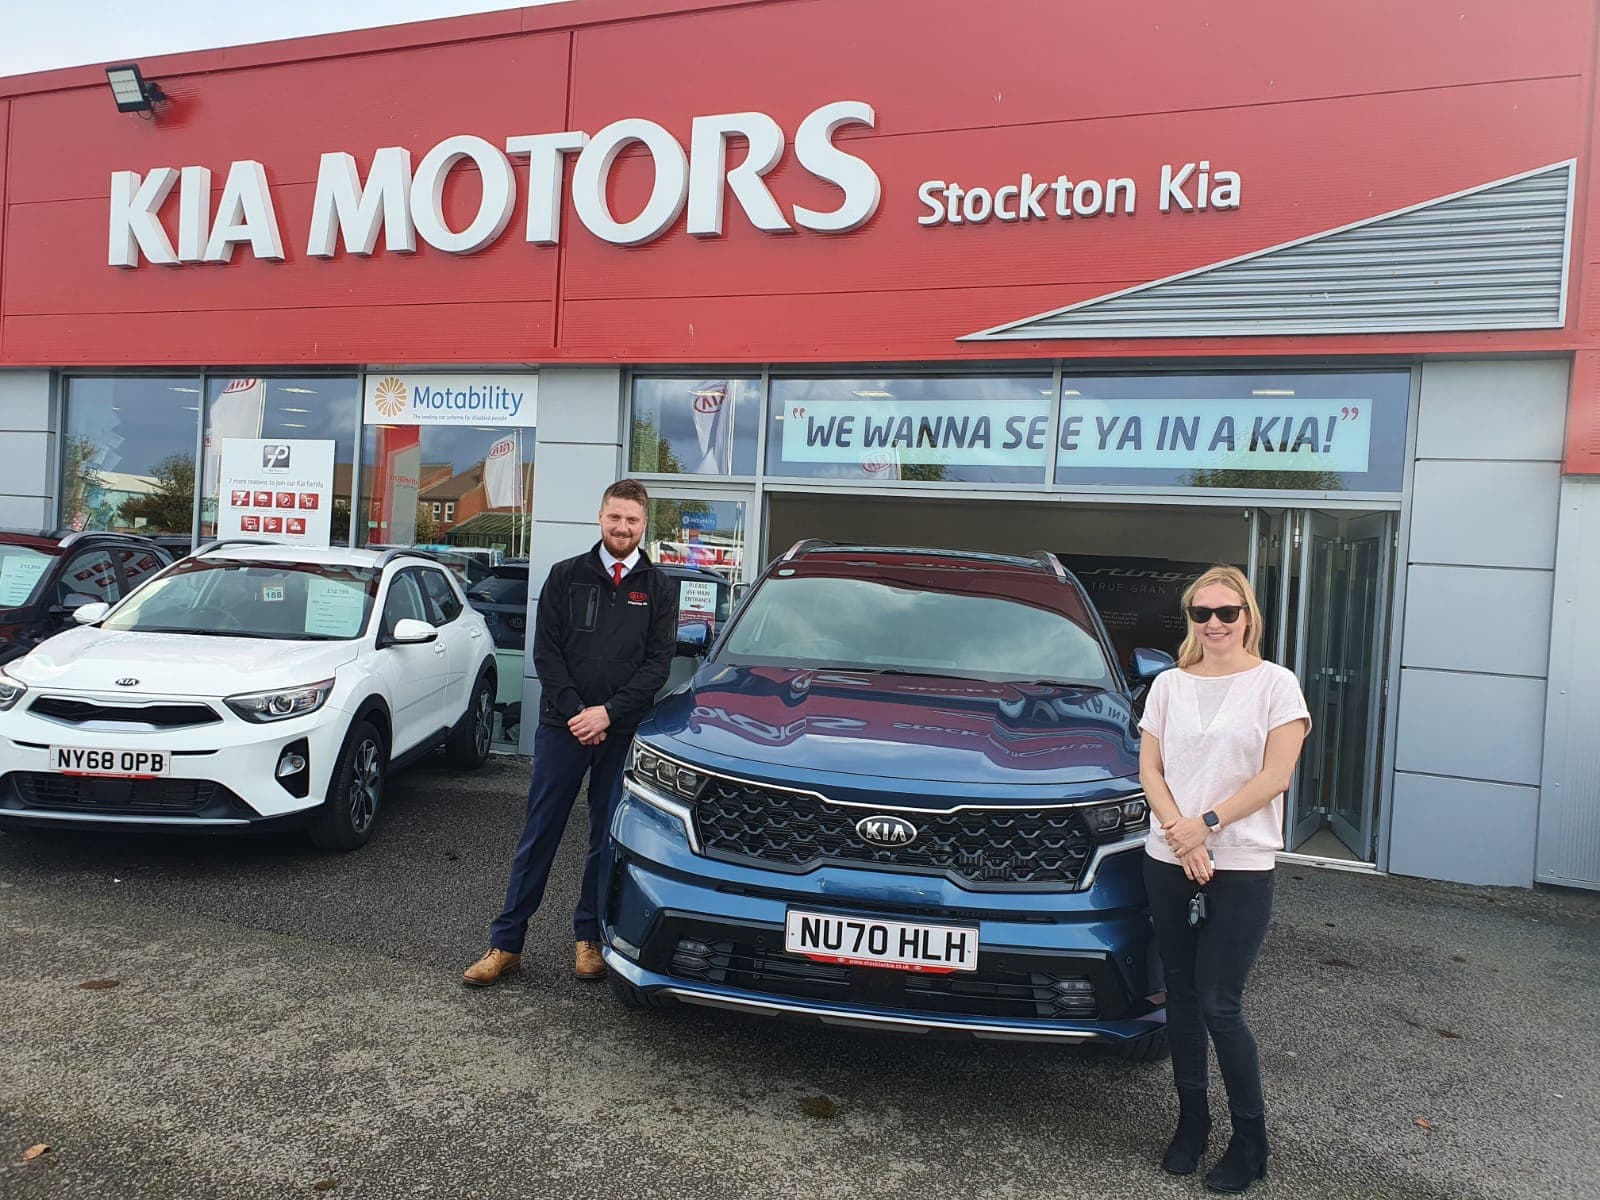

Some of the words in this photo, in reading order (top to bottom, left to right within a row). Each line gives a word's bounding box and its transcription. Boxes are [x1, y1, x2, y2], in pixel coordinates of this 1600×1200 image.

[108, 159, 285, 268] KIA
[306, 100, 881, 257] MOTORS
[917, 172, 1137, 227] Stockton
[1158, 160, 1242, 213] Kia
[413, 385, 524, 417] Motability
[863, 415, 991, 449] WANNA
[1095, 415, 1143, 451] YA
[1156, 415, 1201, 451] IN
[1208, 415, 1236, 452] A
[265, 591, 282, 599] 188
[1090, 582, 1125, 592] TRUE
[1130, 584, 1166, 594] GRAN
[117, 678, 138, 686] KIA
[58, 748, 115, 769] NY68
[121, 752, 164, 772] OPB
[866, 821, 907, 842] KIA
[800, 916, 888, 955] NU70
[899, 927, 967, 963] HLH
